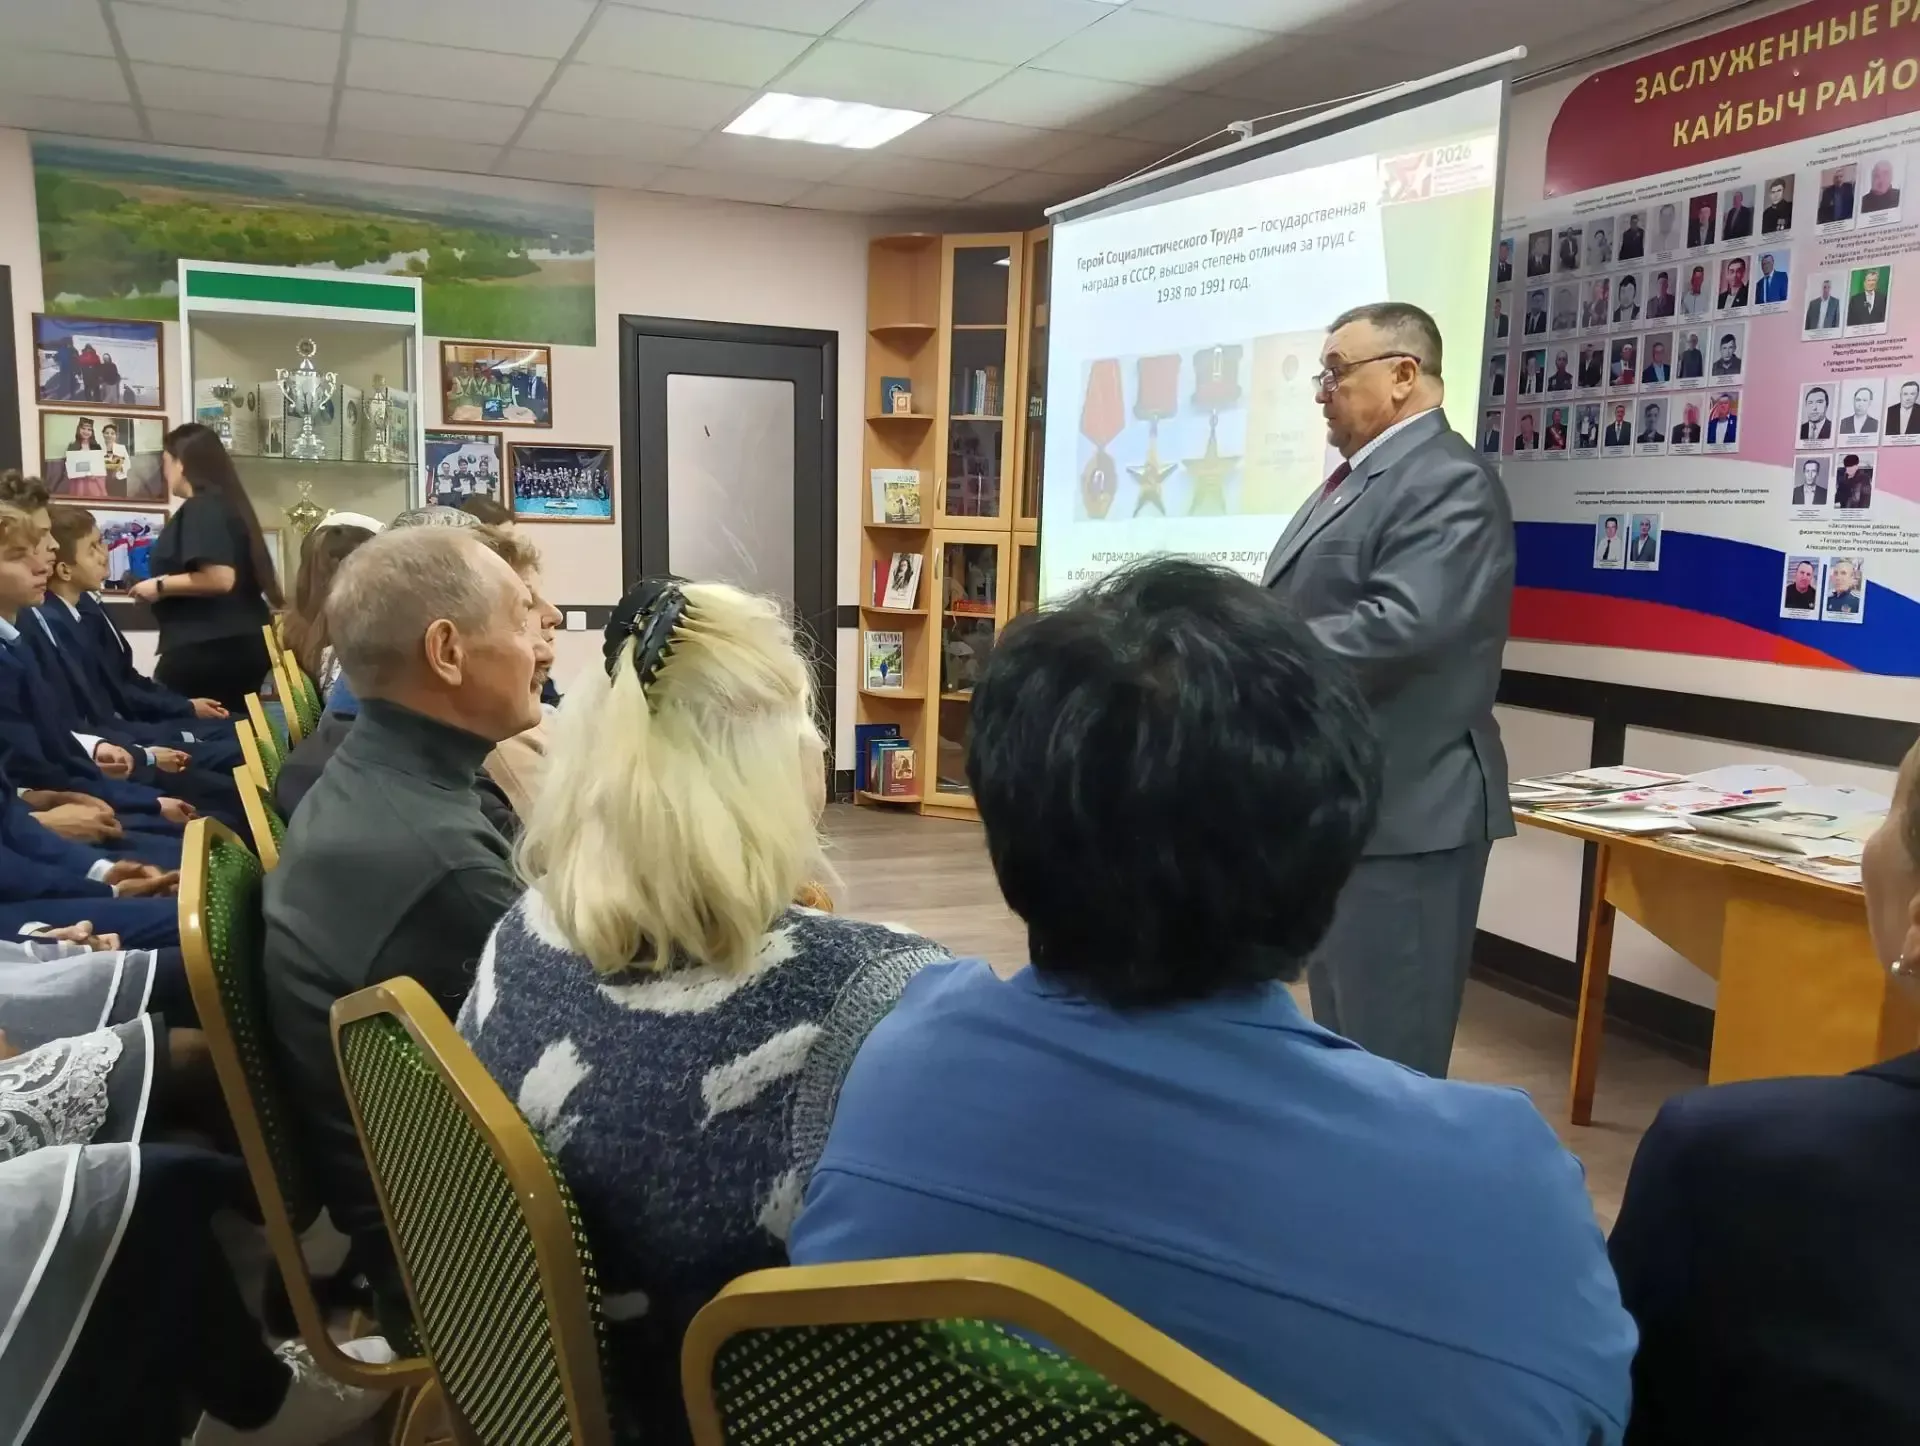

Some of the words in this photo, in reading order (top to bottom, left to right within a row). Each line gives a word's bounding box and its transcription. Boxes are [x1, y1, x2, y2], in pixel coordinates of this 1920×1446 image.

[1634, 3, 1879, 104] ЗАСЛУЖЕННЫЕ
[1672, 87, 1806, 147] КАЙБЫЧ
[1436, 143, 1472, 166] 2026
[1077, 252, 1105, 272] Герой
[1106, 233, 1208, 268] Социалистического
[1210, 226, 1244, 247] Труда
[1260, 200, 1366, 233] государственная
[1082, 274, 1119, 294] награда
[1122, 274, 1128, 285] в
[1129, 265, 1157, 284] СССР,
[1159, 260, 1199, 280] высшая
[1201, 251, 1247, 271] степень
[1248, 241, 1297, 262] отличия
[1299, 238, 1313, 252] за
[1316, 232, 1345, 251] труд
[1157, 285, 1182, 304] 1938
[1183, 285, 1197, 298] по
[1200, 278, 1226, 297] 1991
[1229, 276, 1252, 292] год.
